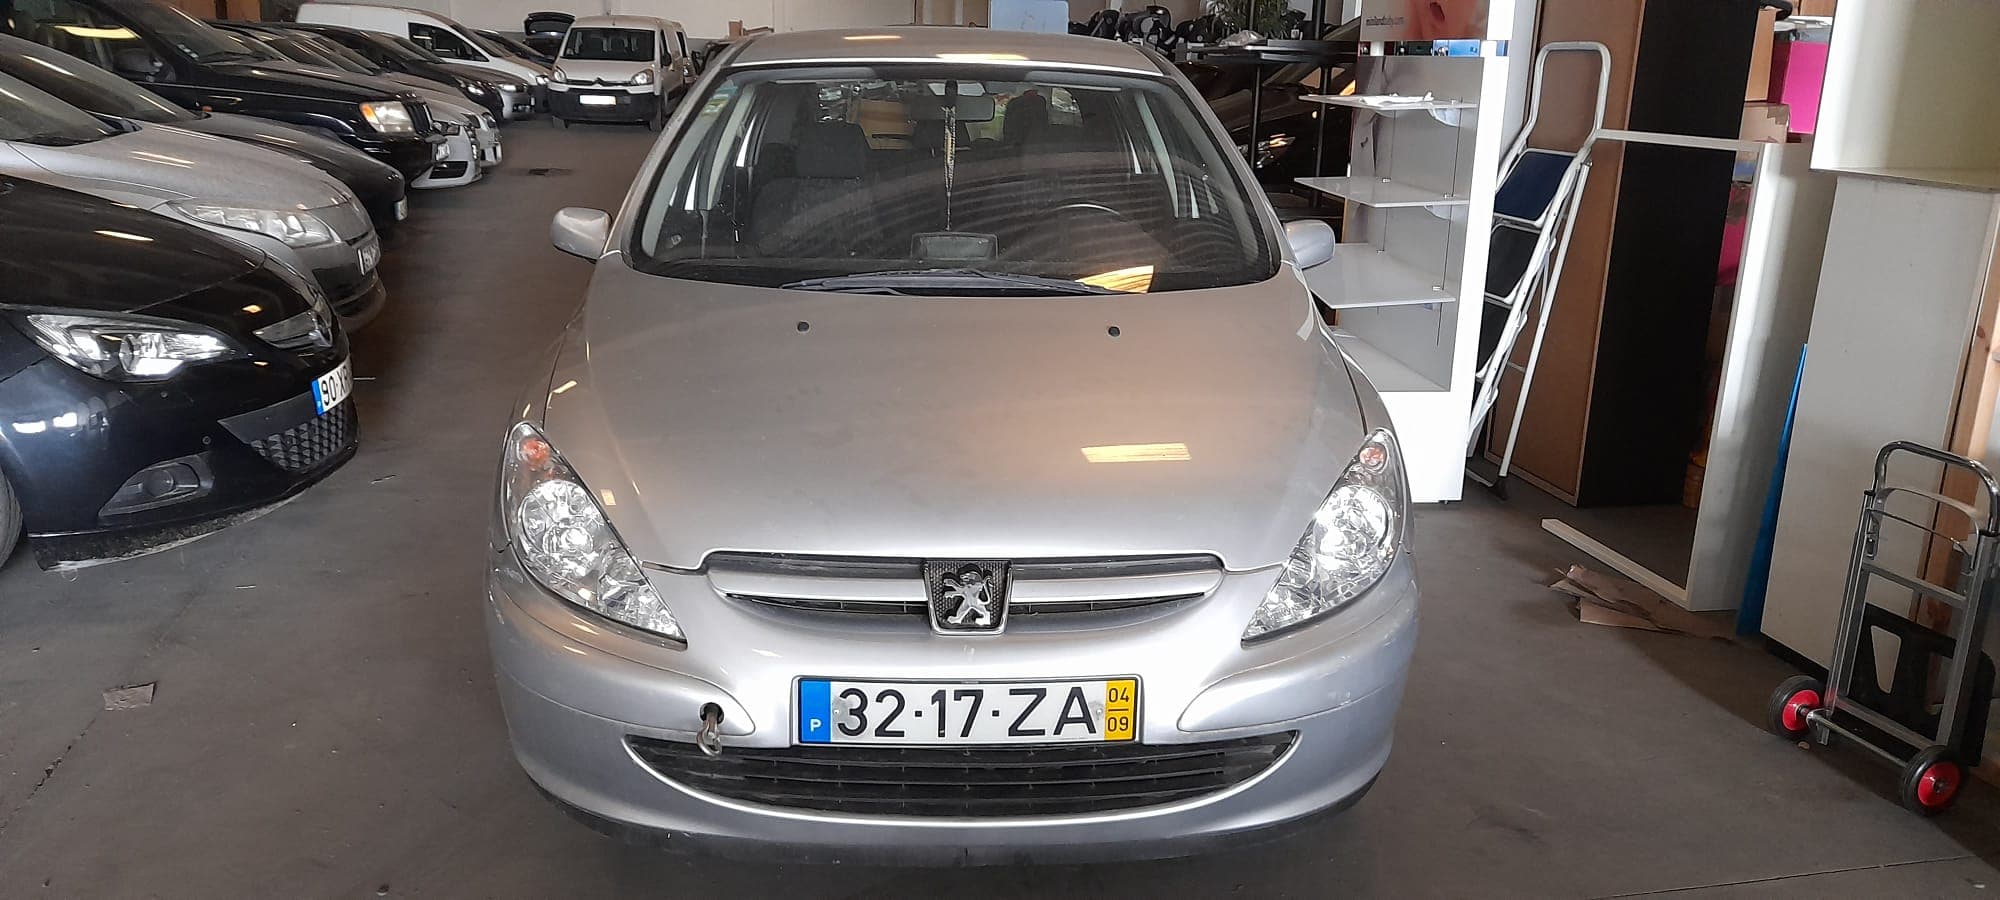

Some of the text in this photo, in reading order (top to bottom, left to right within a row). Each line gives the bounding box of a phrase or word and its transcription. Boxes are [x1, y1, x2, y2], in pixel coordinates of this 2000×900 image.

[1109, 687, 1130, 703] 04
[810, 718, 821, 732] P
[1107, 716, 1129, 732] 09
